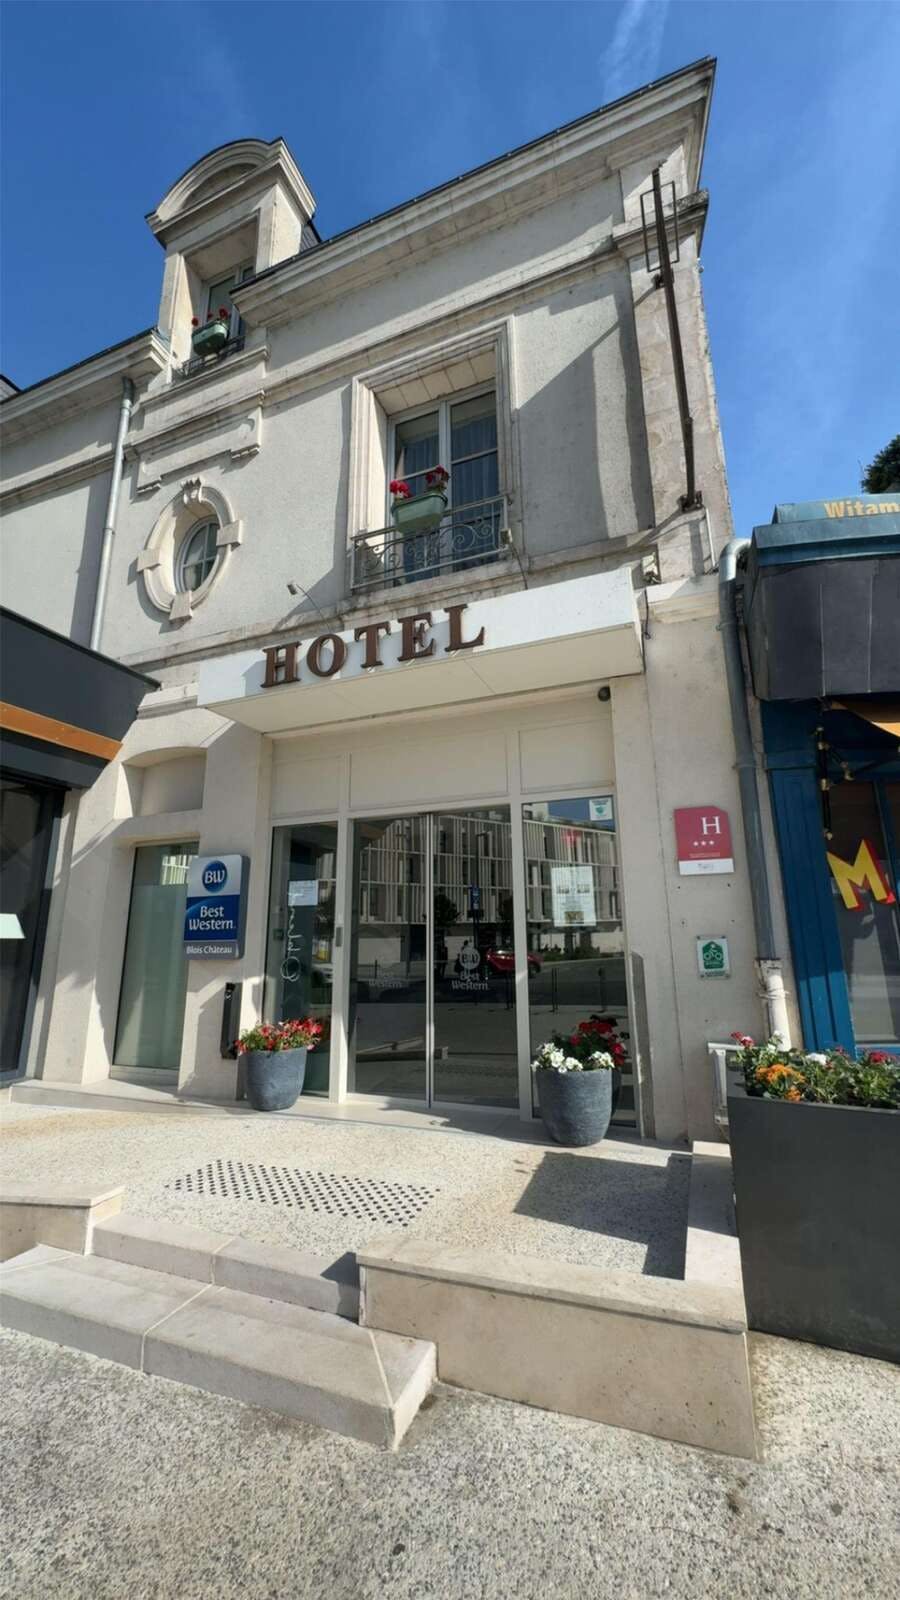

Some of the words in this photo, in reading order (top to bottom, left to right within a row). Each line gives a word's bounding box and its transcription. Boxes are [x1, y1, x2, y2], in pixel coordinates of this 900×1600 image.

[260, 603, 485, 689] HOTEL
[700, 815, 722, 835] H
[204, 870, 226, 884] BW
[200, 905, 225, 918] Best
[188, 918, 234, 931] Western
[186, 945, 203, 954] Blois
[203, 944, 233, 954] Château
[460, 970, 480, 981] Best
[451, 979, 489, 991] Western
